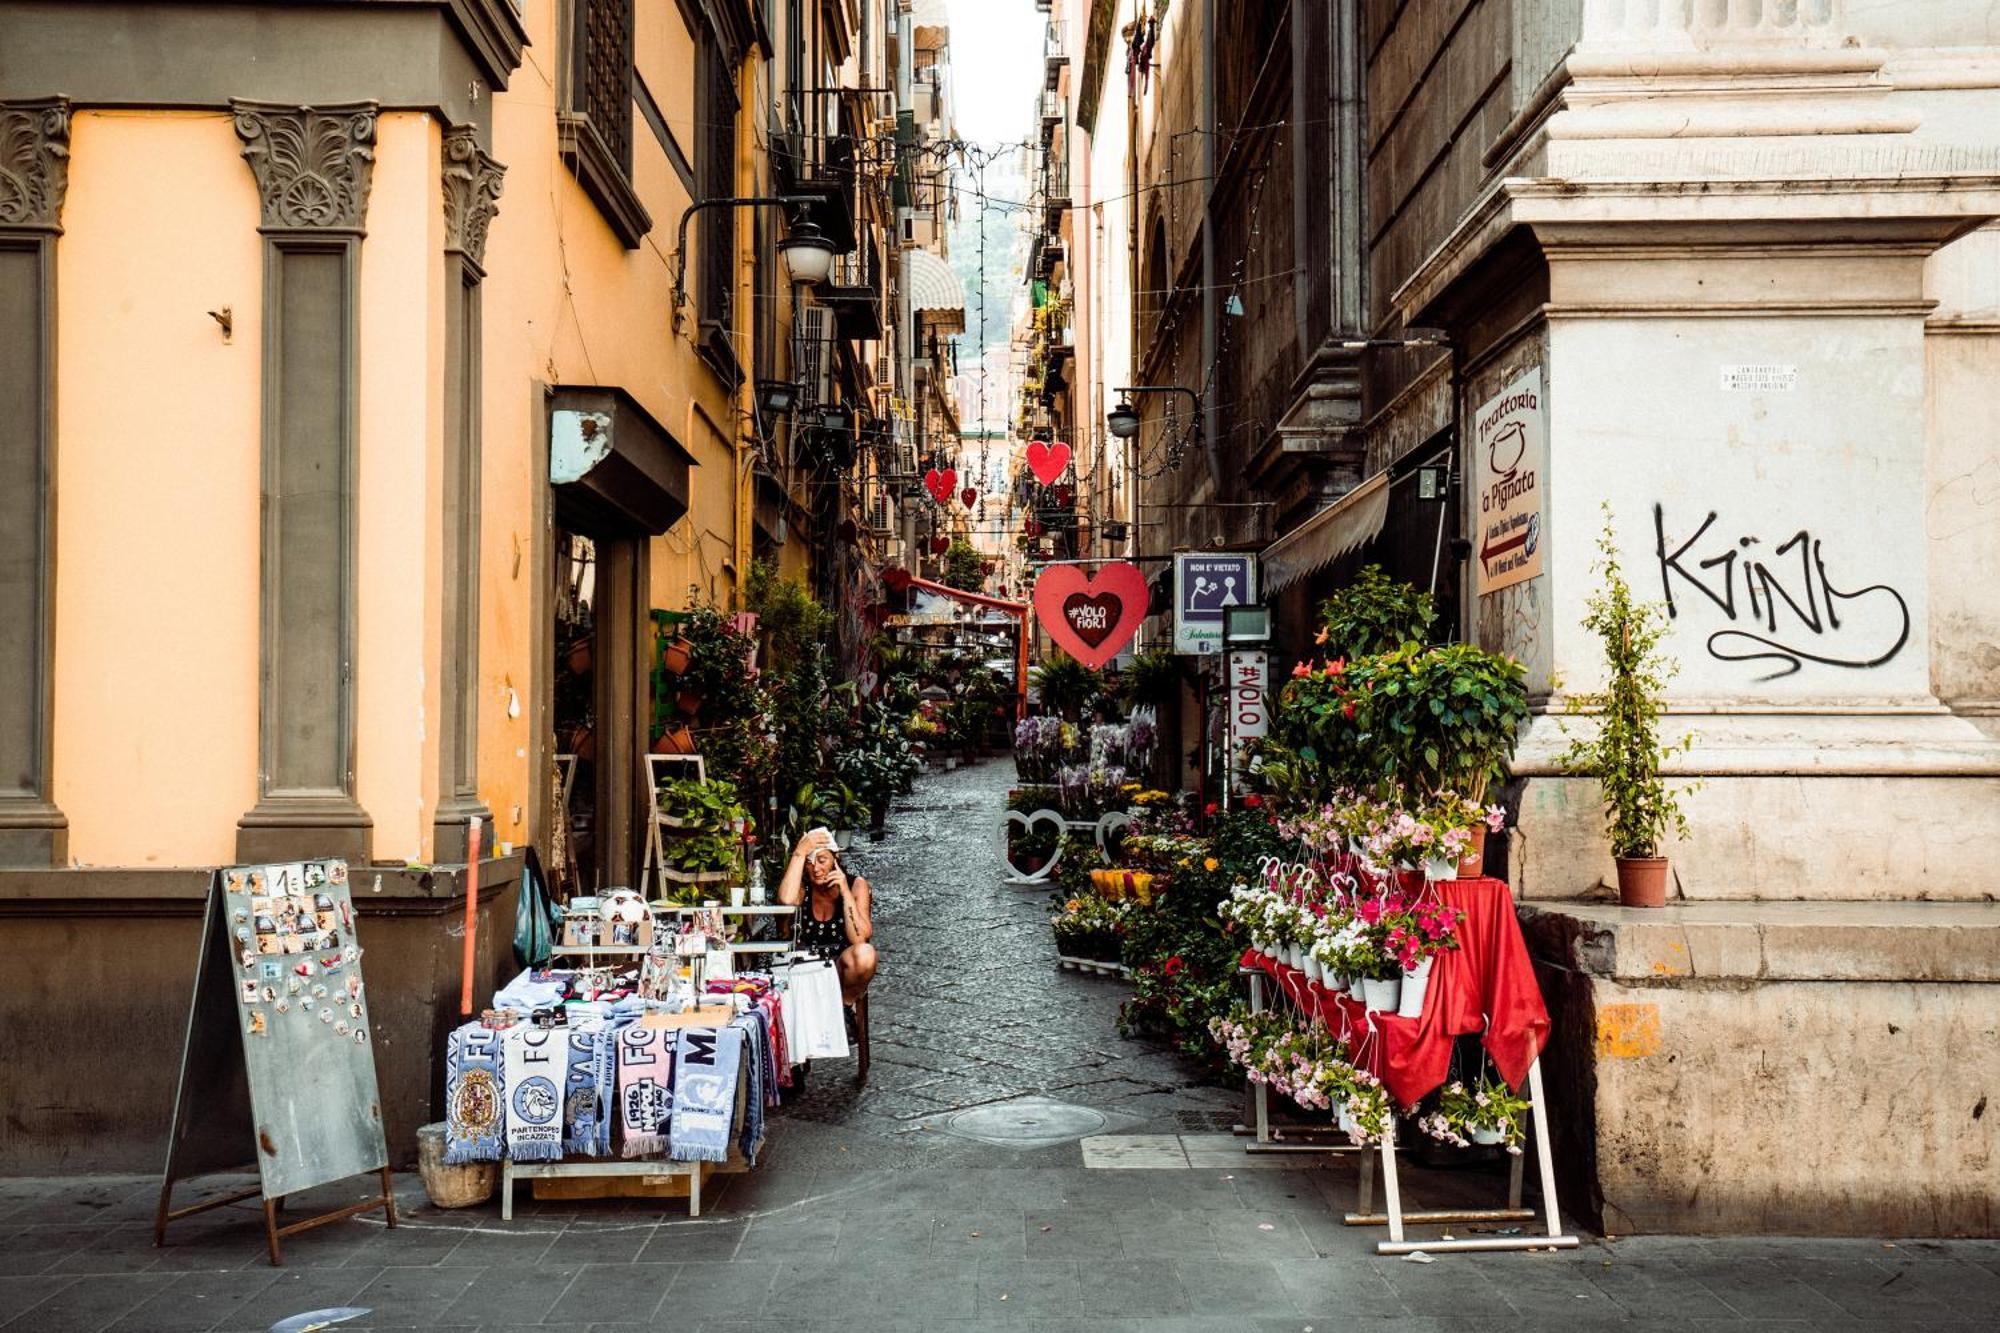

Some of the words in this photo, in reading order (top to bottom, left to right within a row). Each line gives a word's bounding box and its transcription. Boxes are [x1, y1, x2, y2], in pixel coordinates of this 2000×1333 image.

[1479, 387, 1537, 443] Trattoria
[1491, 470, 1535, 512] Pignata
[1190, 563, 1205, 572] NON
[1213, 563, 1241, 572] VIETATO
[1068, 604, 1107, 619] #VOLO
[1076, 616, 1106, 629] FIORI
[628, 1090, 639, 1122] 1926
[640, 1079, 656, 1130] NAPOLI
